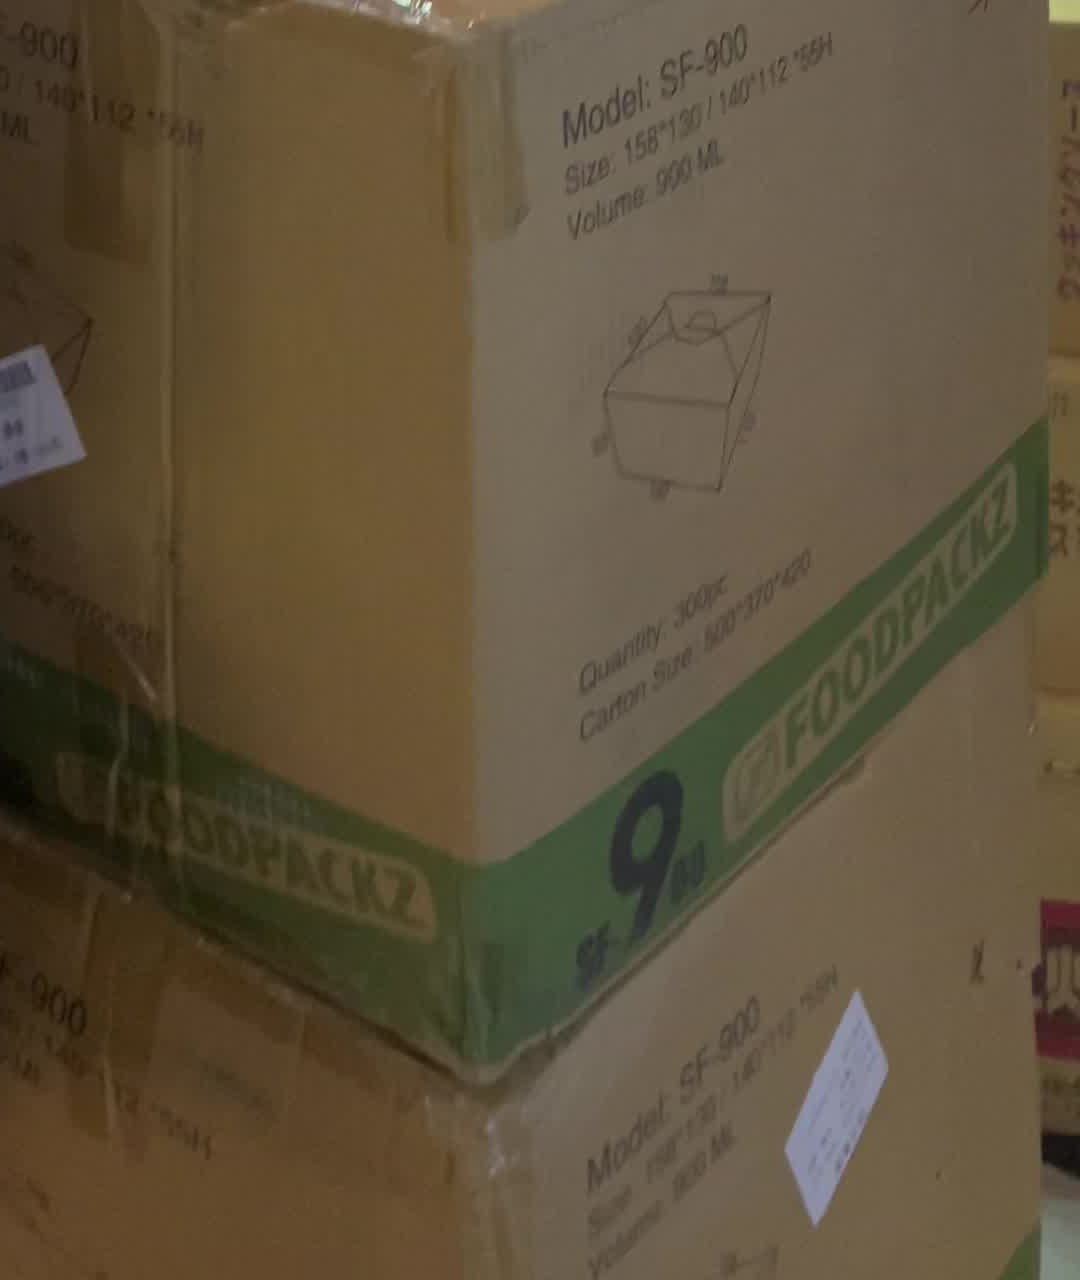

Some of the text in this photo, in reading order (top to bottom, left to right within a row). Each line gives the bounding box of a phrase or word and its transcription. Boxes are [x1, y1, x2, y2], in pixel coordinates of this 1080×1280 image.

[562, 23, 748, 149] Model: SF-900
[783, 476, 1012, 770] FOODPACKZ
